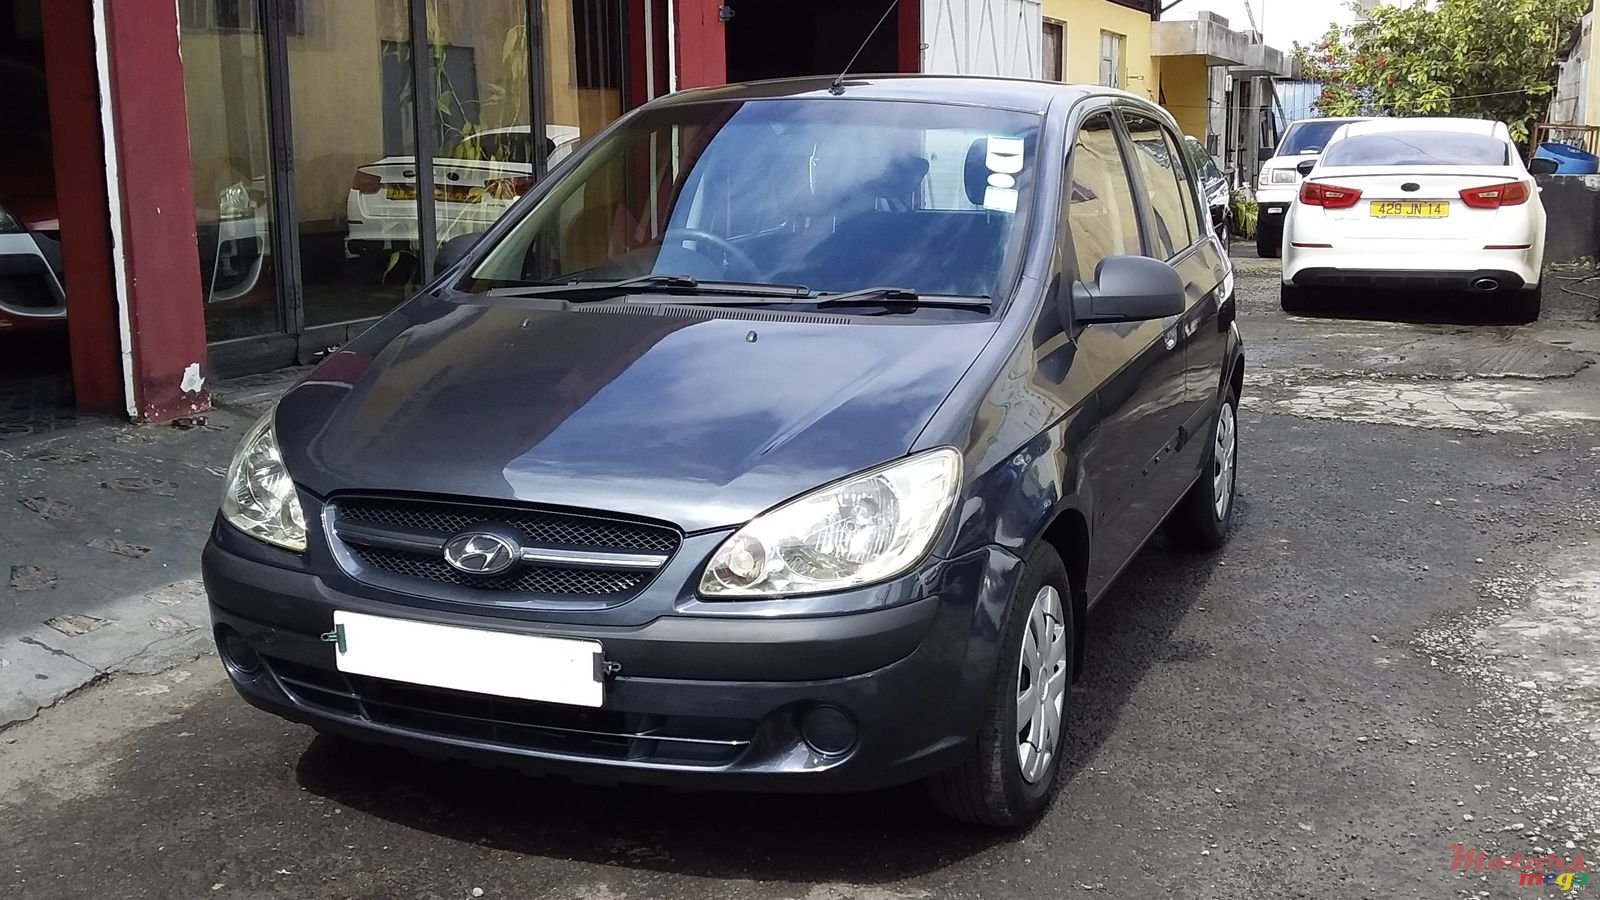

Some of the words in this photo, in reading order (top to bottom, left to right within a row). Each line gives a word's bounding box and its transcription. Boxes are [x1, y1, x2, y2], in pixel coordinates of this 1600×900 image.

[1378, 203, 1402, 215] 429
[1406, 203, 1422, 215] JN
[1428, 203, 1441, 215] 14
